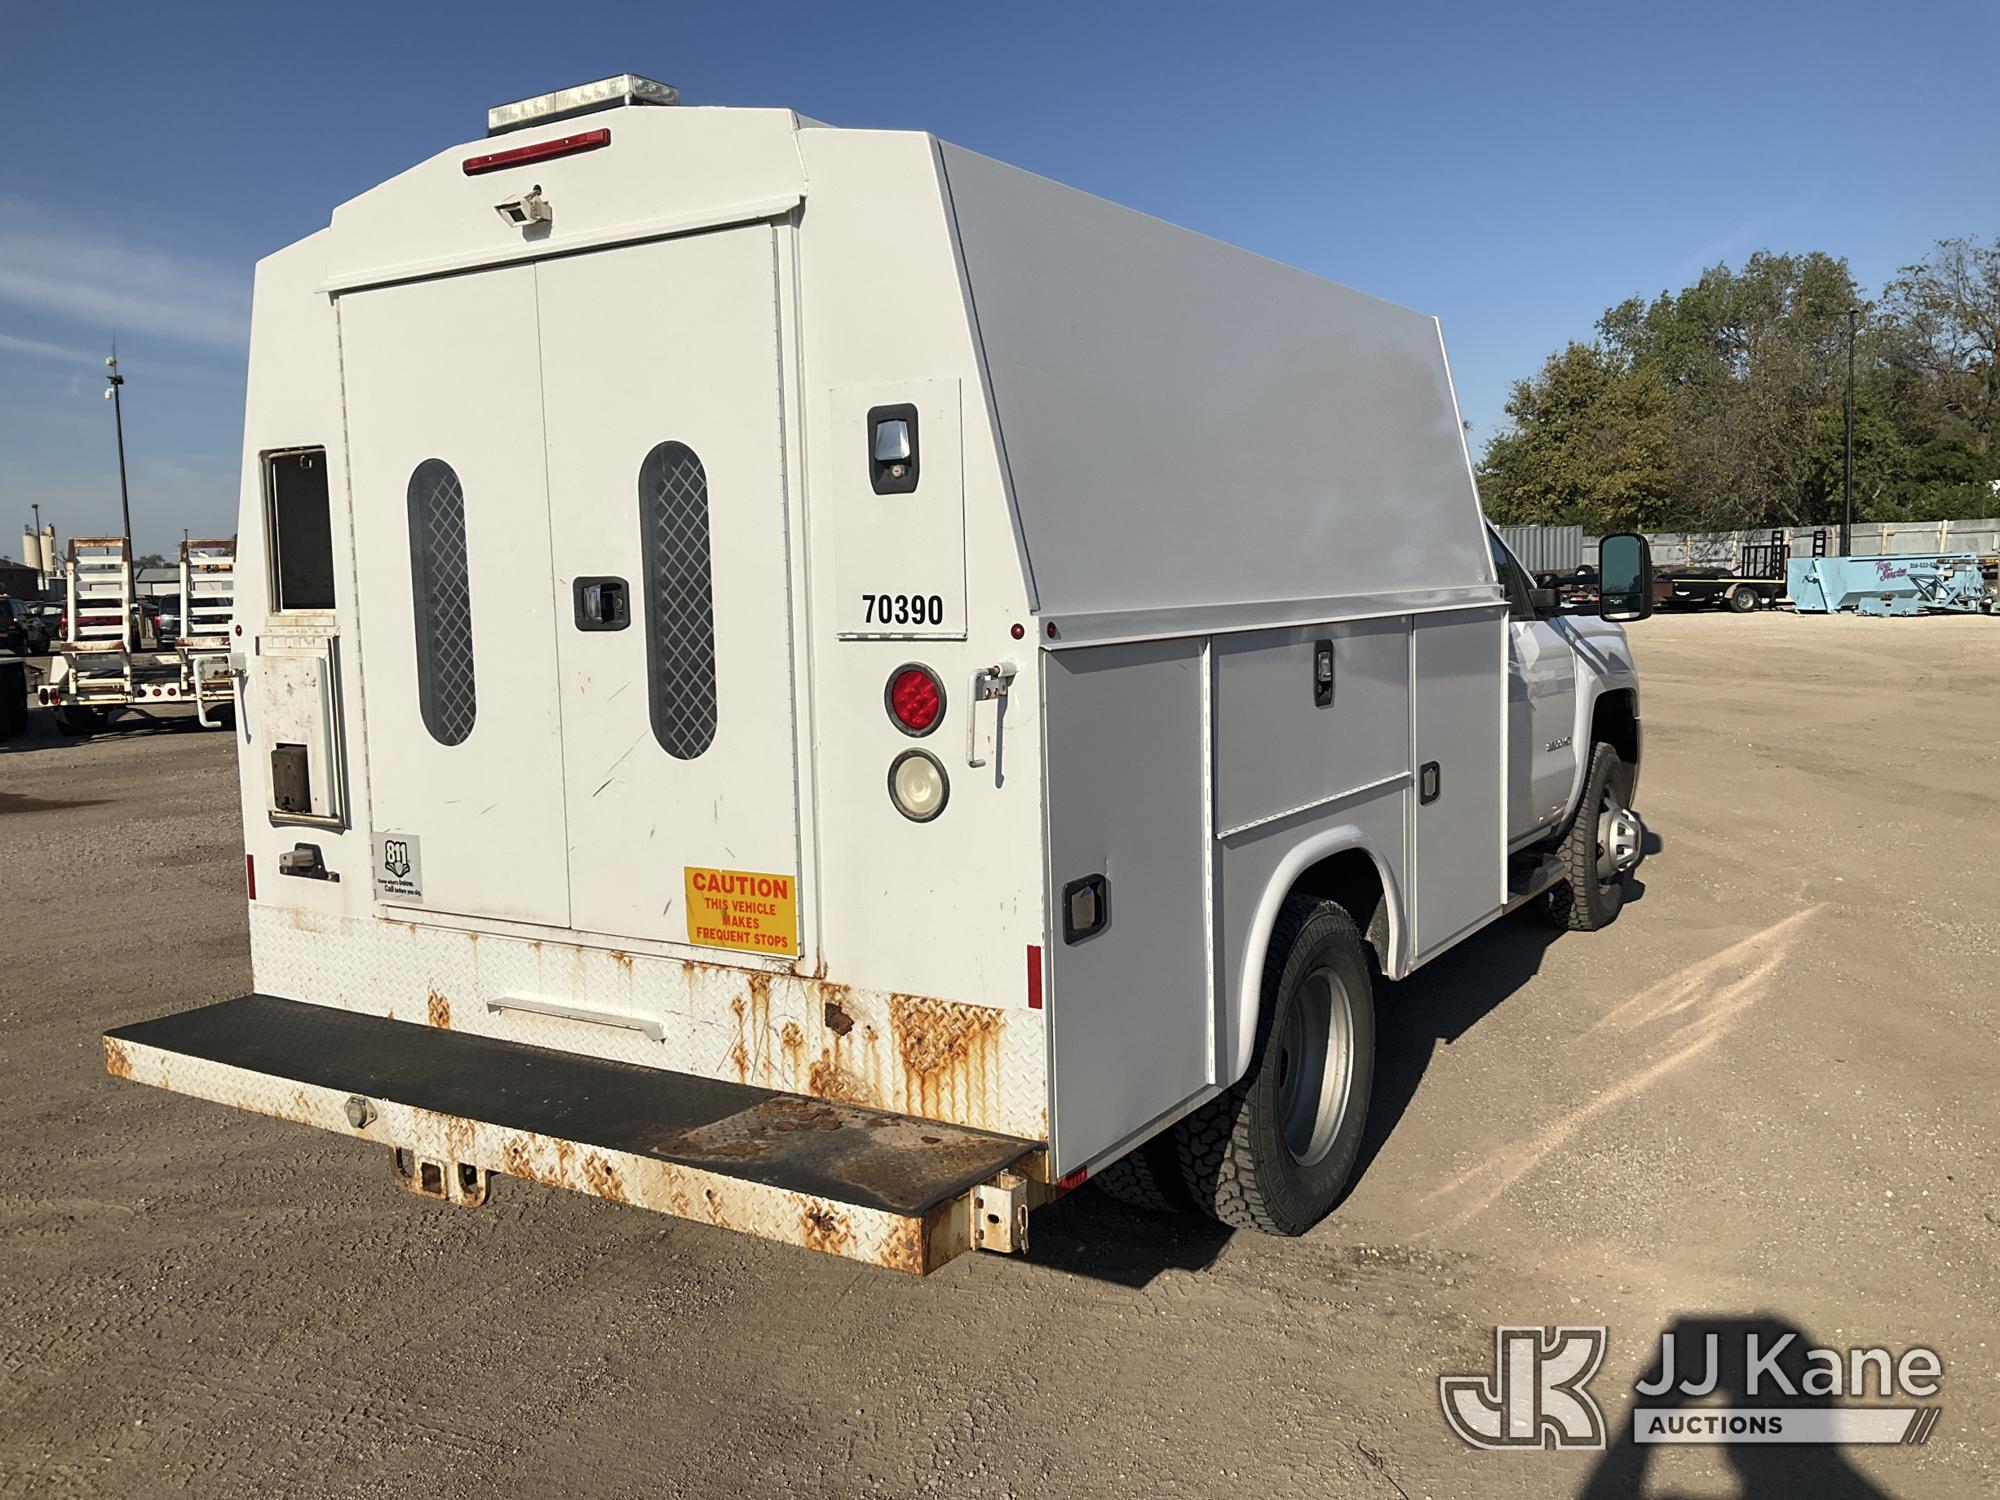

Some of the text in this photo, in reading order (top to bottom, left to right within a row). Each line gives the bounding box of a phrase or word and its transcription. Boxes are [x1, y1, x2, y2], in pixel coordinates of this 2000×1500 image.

[862, 594, 943, 625] 70390
[385, 840, 408, 865] 811
[692, 872, 788, 899] CAUTION
[705, 897, 776, 916] THIS VEHICLE
[722, 915, 759, 929] MAKES
[696, 927, 788, 948] FREQUENT STOPS
